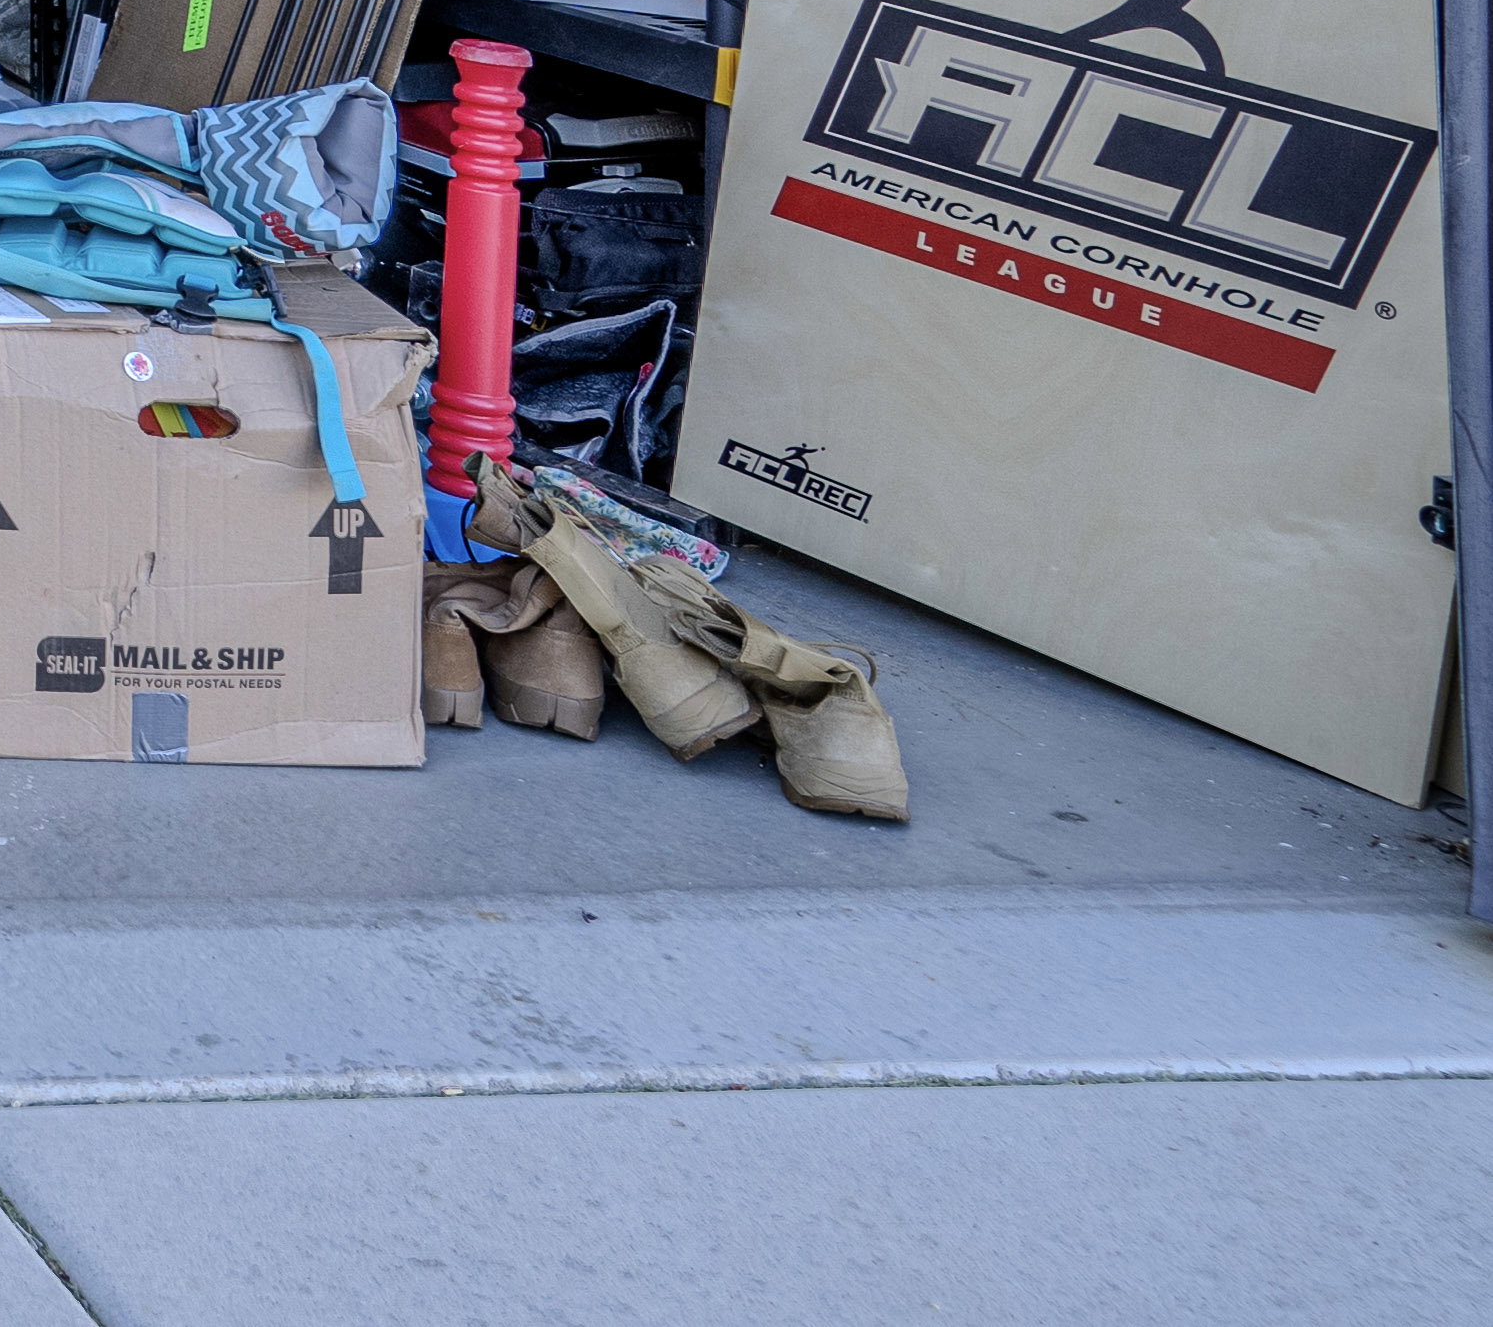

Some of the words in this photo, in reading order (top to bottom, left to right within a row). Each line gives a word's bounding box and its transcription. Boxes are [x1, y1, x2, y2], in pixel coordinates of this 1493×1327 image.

[867, 25, 1347, 271] ACL
[810, 161, 1039, 243] AMERICAN
[1049, 233, 1326, 333] CORNHOLE
[915, 231, 1163, 327] LEAGUE
[728, 446, 796, 490] ACL
[802, 476, 863, 514] REC
[333, 507, 365, 539] UP
[113, 644, 187, 671] MAIL
[190, 645, 213, 671] &
[216, 647, 285, 671] SHIP
[114, 676, 142, 689] FOR
[144, 676, 183, 689] YOUR
[186, 677, 237, 689] POSTAL
[239, 678, 282, 690] NEEDS
